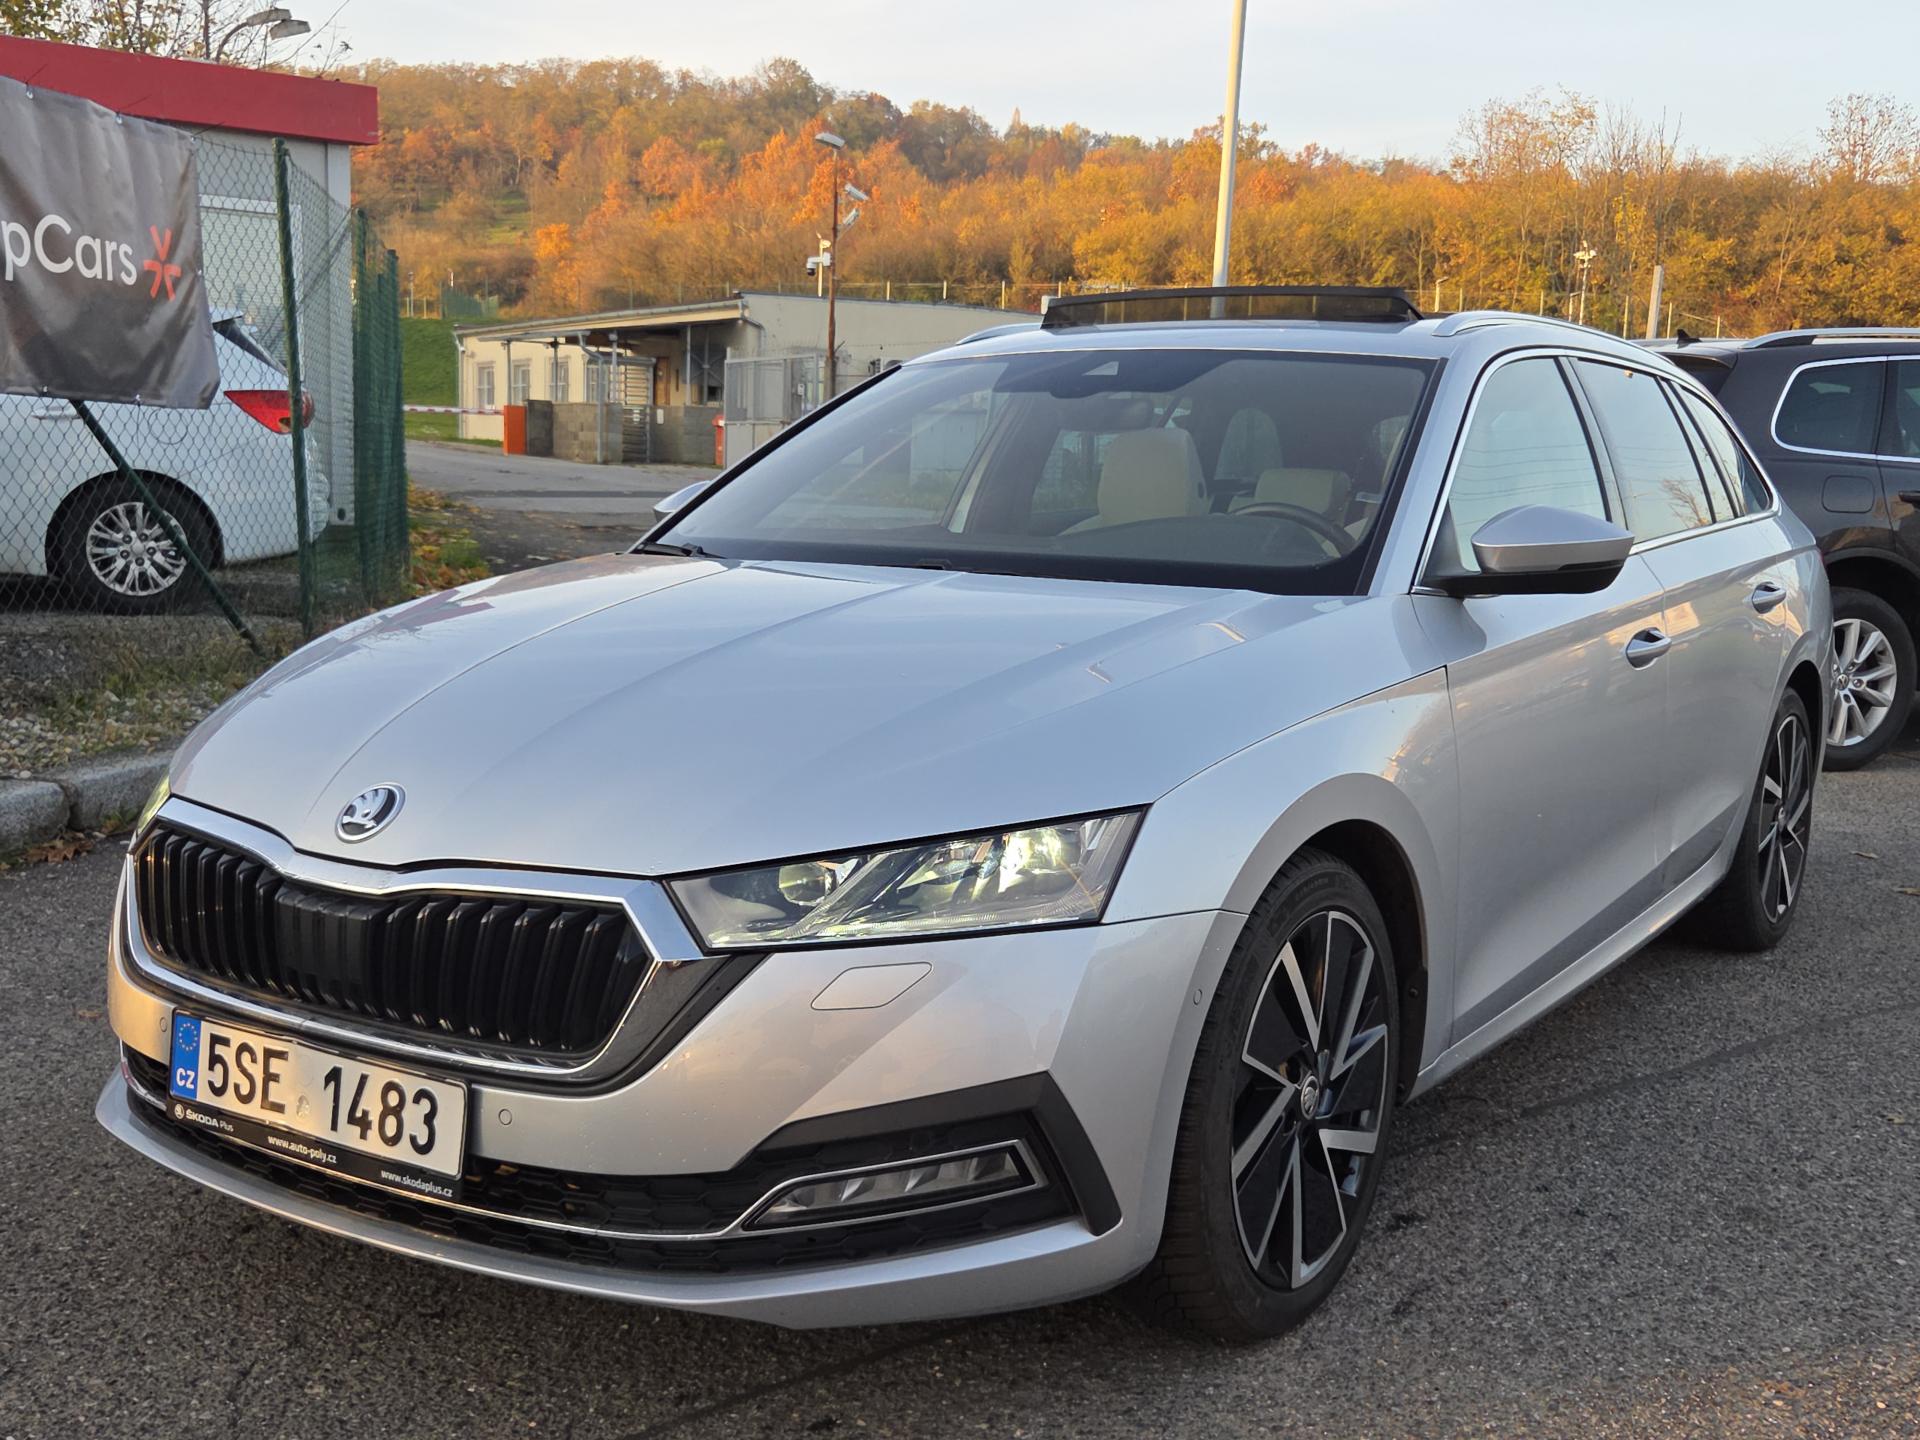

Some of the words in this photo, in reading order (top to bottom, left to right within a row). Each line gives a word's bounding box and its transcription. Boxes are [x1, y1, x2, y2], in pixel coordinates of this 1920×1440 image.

[1, 214, 137, 285] pCars
[175, 1067, 195, 1090] CZ
[207, 1032, 289, 1114] 5SE
[323, 1065, 438, 1155] 1483
[185, 1108, 219, 1128] ŠKODA
[219, 1120, 234, 1132] Plus
[267, 1135, 337, 1164] www.auto-poly.cz
[380, 1169, 453, 1197] www.skodaplus.cz
